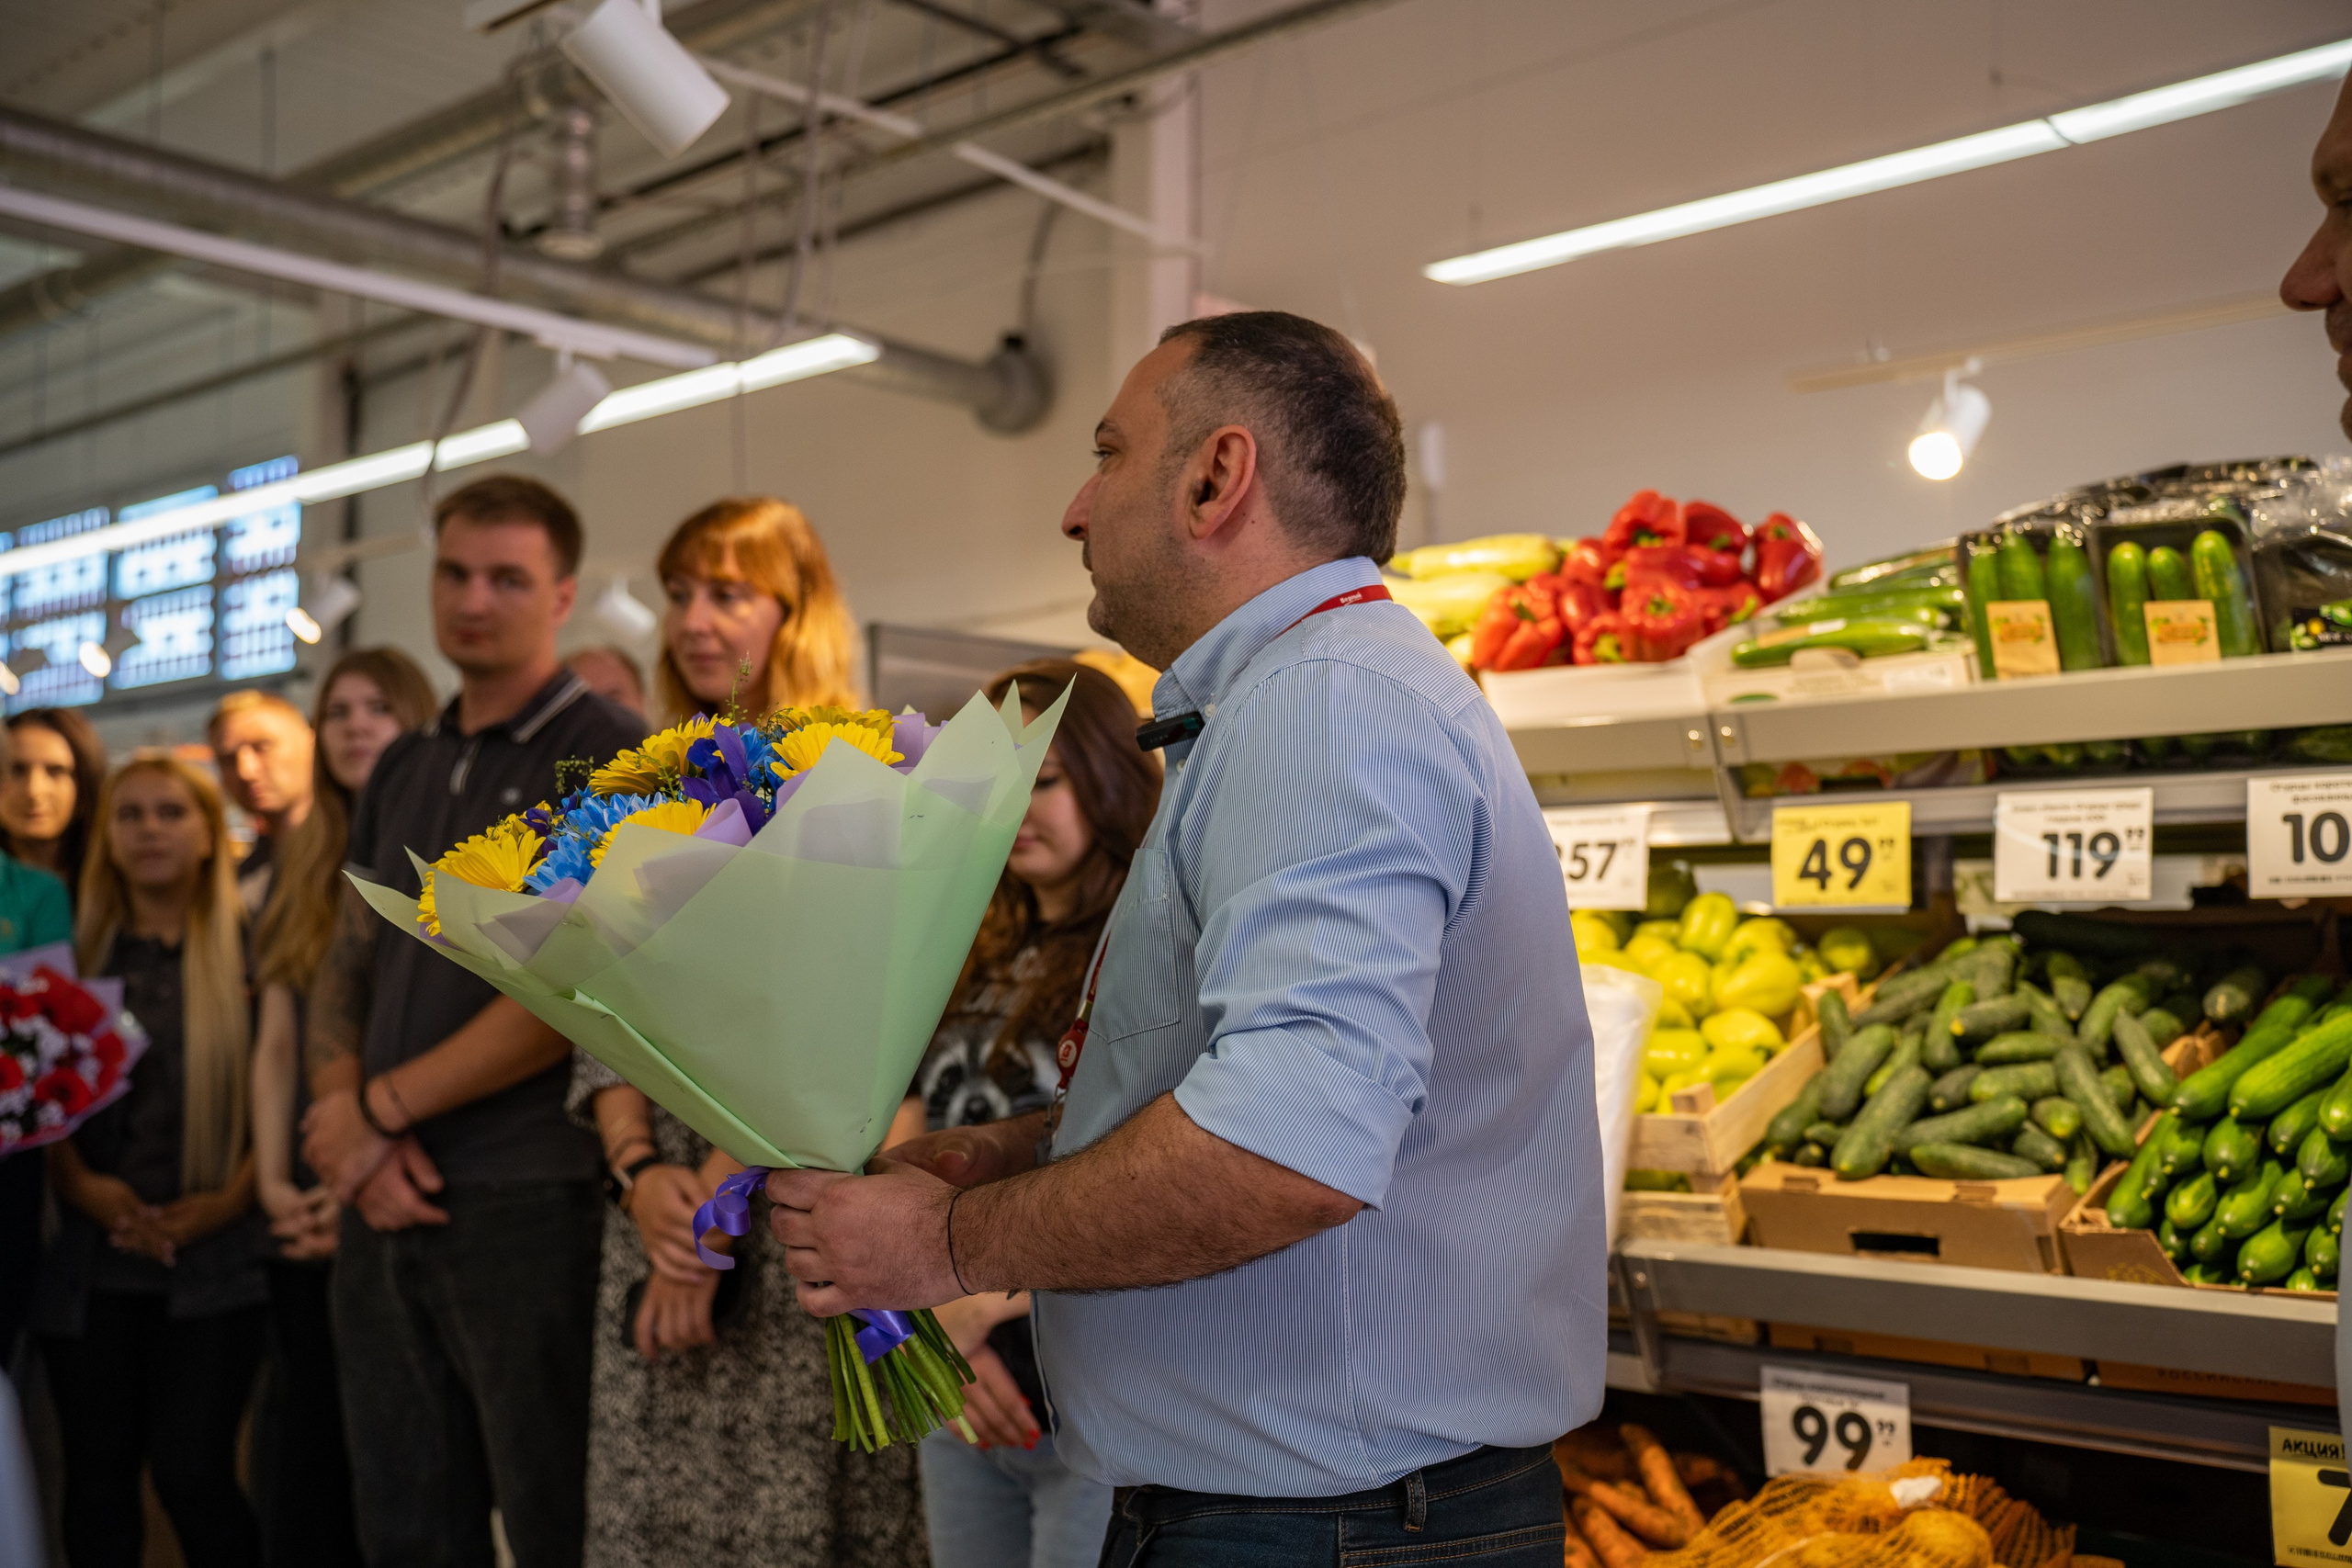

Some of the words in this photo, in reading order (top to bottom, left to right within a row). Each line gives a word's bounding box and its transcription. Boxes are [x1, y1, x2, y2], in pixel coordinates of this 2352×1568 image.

[1554, 842, 1617, 880] 57
[1798, 837, 1872, 890] 49
[2042, 831, 2120, 878] 119
[2283, 812, 2350, 863] 10
[1793, 1406, 1871, 1471] 99
[2317, 1469, 2352, 1547] 7
